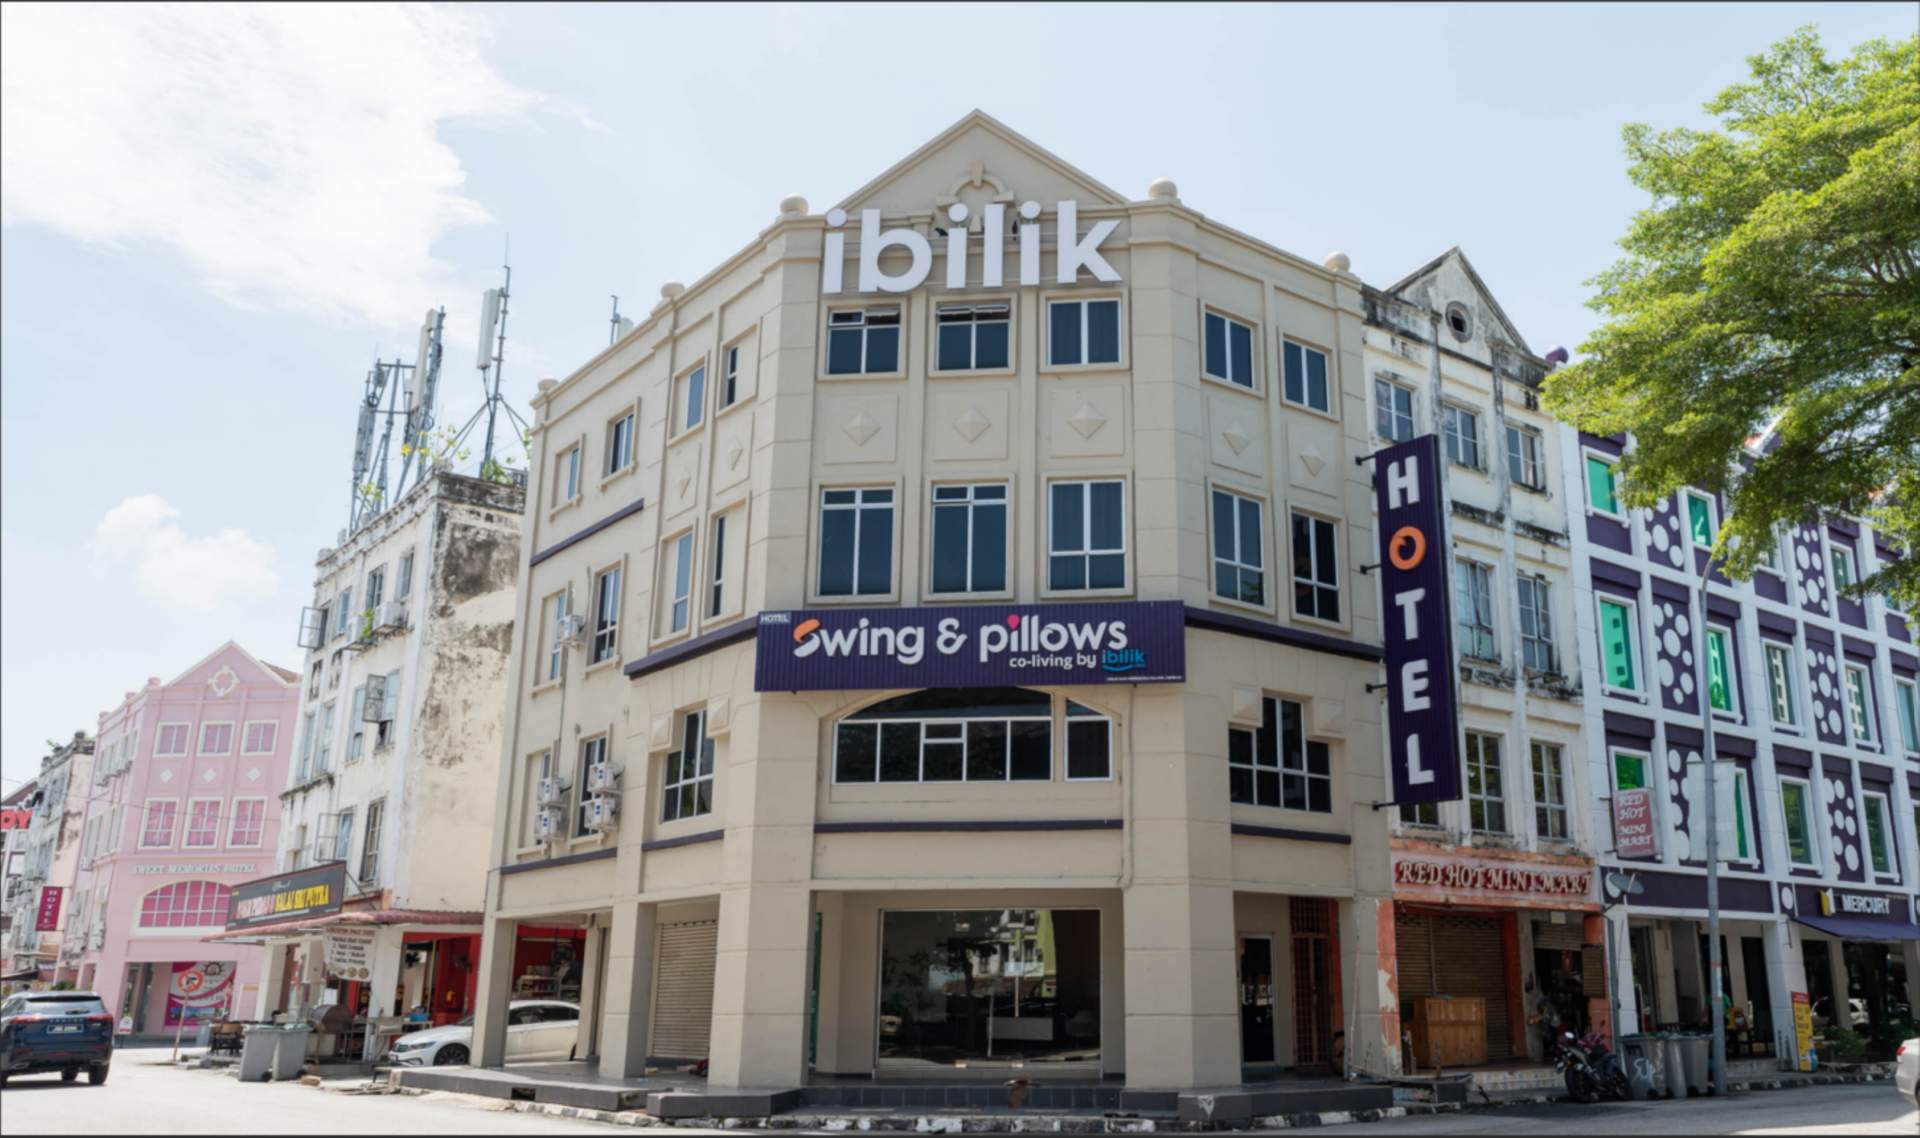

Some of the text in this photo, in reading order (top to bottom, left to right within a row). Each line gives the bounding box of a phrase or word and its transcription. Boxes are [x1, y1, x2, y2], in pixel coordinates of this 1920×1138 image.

[822, 200, 1123, 294] ibilik
[760, 614, 789, 623] HOTEL
[1387, 455, 1435, 786] HOTEL
[793, 614, 1128, 665] Swing & pillows
[1009, 649, 1145, 670] co-living by ibilik
[1619, 793, 1643, 806] RED
[1620, 807, 1647, 819] HOT
[1398, 861, 1592, 895] RED HOT MINI MART
[44, 889, 59, 924] HOTEL
[1841, 894, 1891, 915] MERCURY
